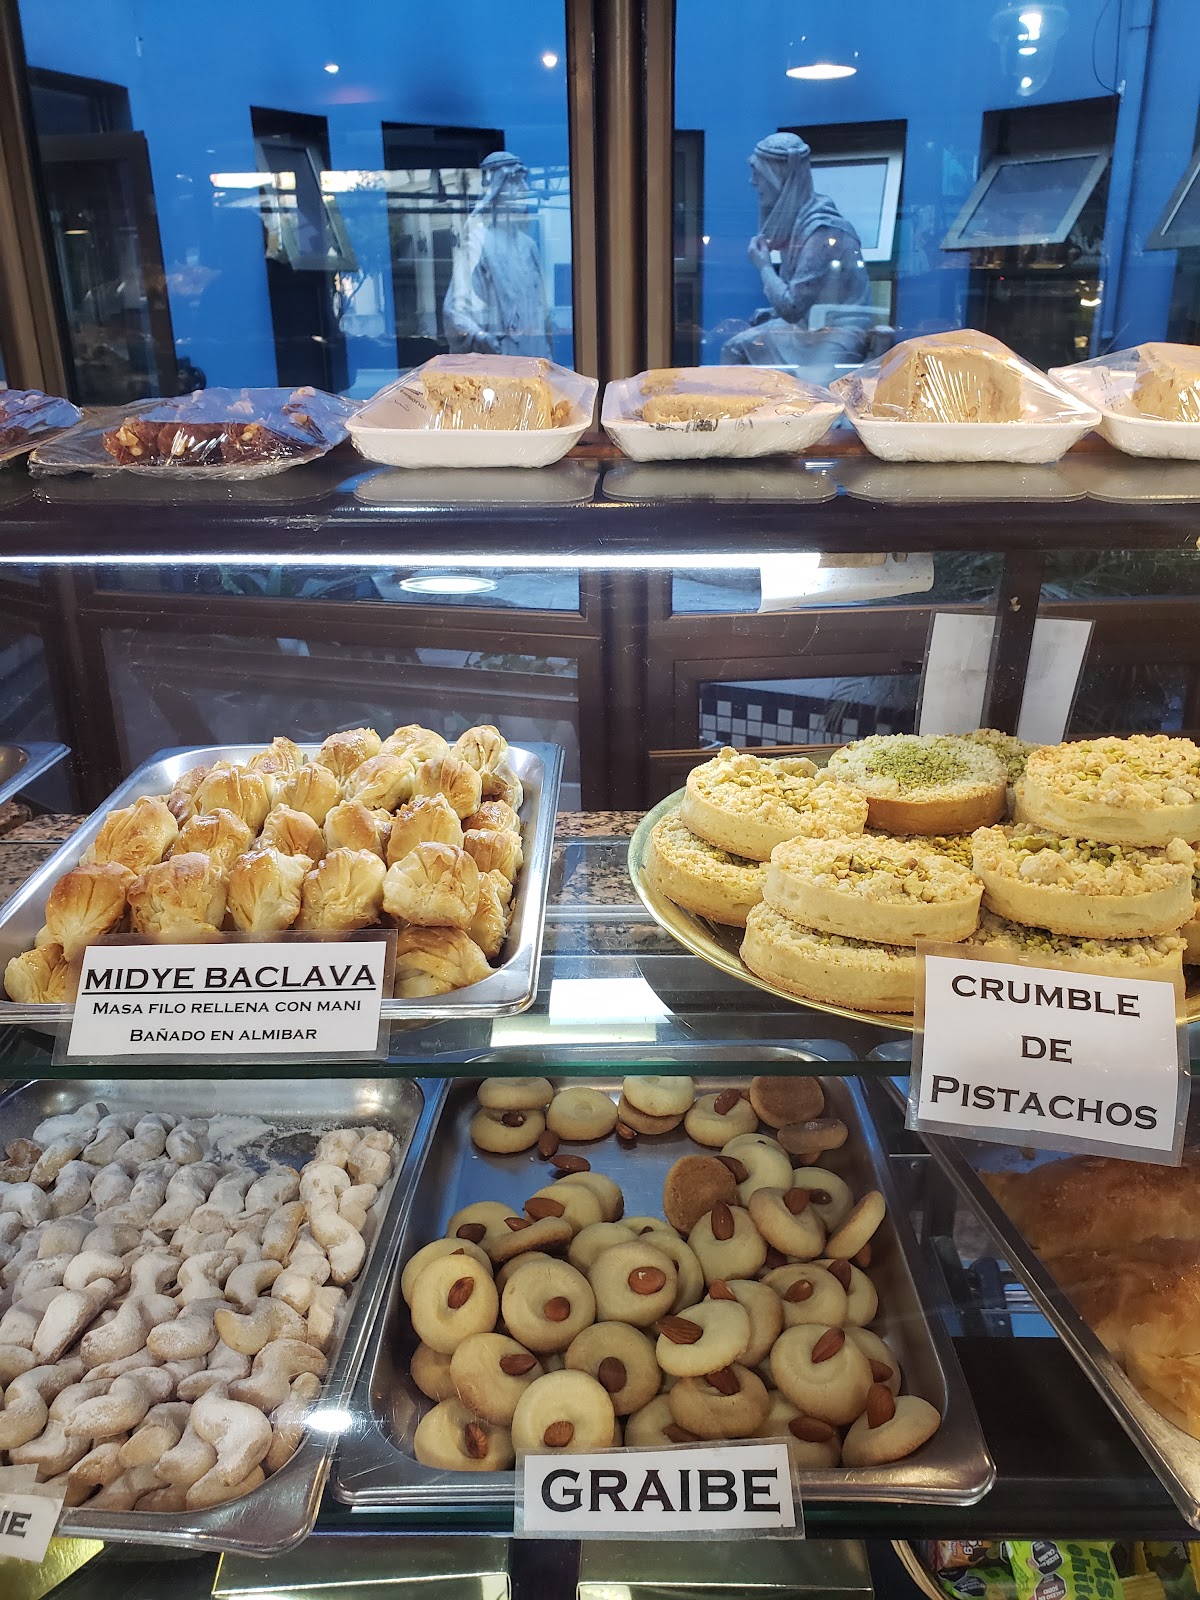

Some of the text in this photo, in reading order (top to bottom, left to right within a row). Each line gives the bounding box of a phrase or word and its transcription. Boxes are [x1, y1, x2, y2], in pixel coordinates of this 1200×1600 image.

[84, 964, 377, 990] MIDYE BACLAVA
[92, 1000, 361, 1015] MASA FILO RELLENA CON MANI
[951, 975, 1141, 1018] CRUMBLE
[129, 1027, 317, 1042] BAÑADO EN ALMIBAR
[1020, 1035, 1073, 1064] DE
[930, 1074, 1158, 1130] PISTACHOS
[541, 1467, 781, 1514] GRAIBE
[0, 1510, 32, 1538] IE
